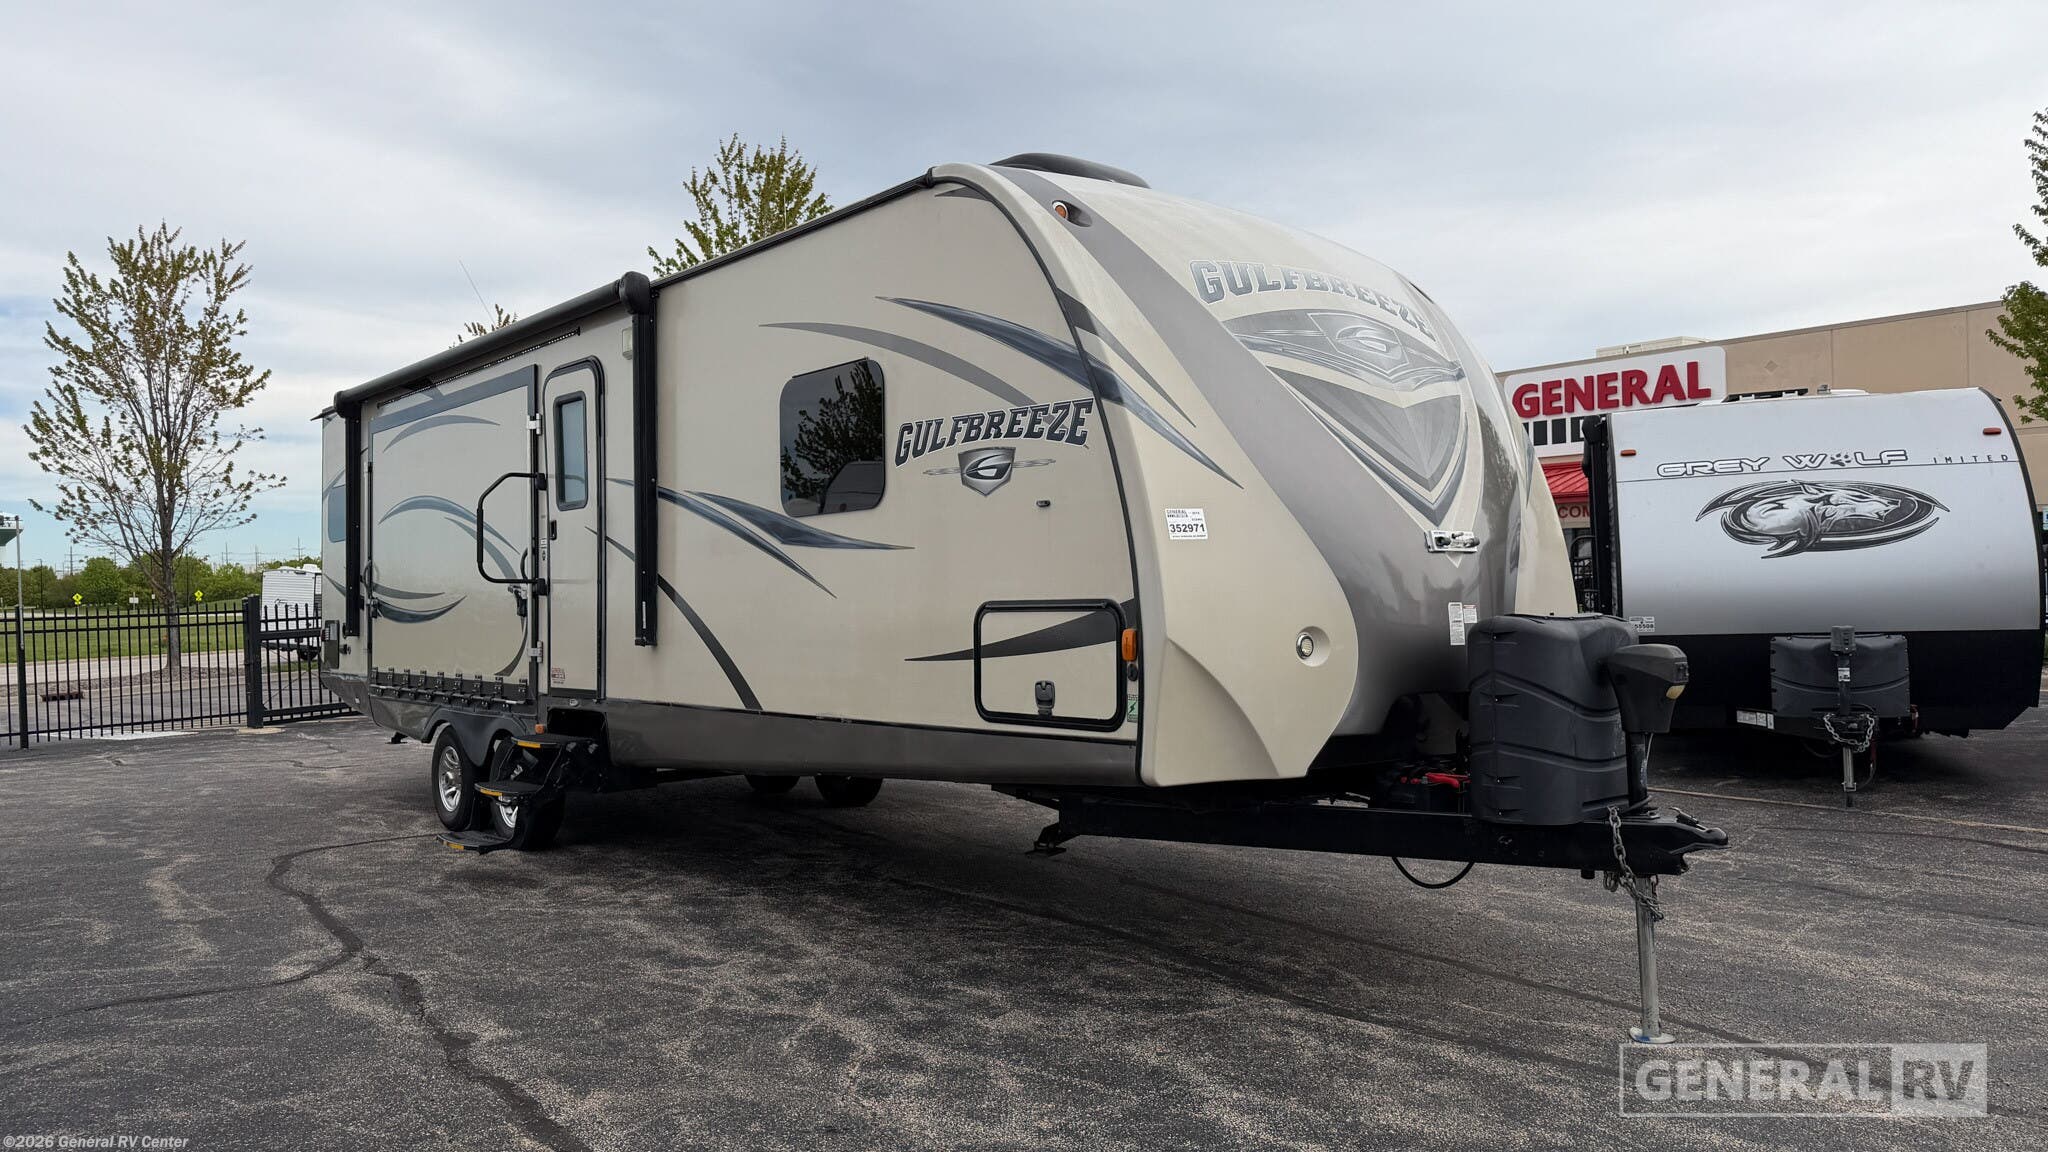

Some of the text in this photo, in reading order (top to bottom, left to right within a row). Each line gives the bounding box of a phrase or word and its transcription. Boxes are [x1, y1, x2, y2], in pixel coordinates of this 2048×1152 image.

[1190, 260, 1437, 342] GULFBREEZE
[1512, 361, 1711, 418] GENERAL
[894, 397, 1094, 468] GULFBREEZE
[1657, 457, 1770, 477] GREY
[1169, 523, 1205, 533] 352971
